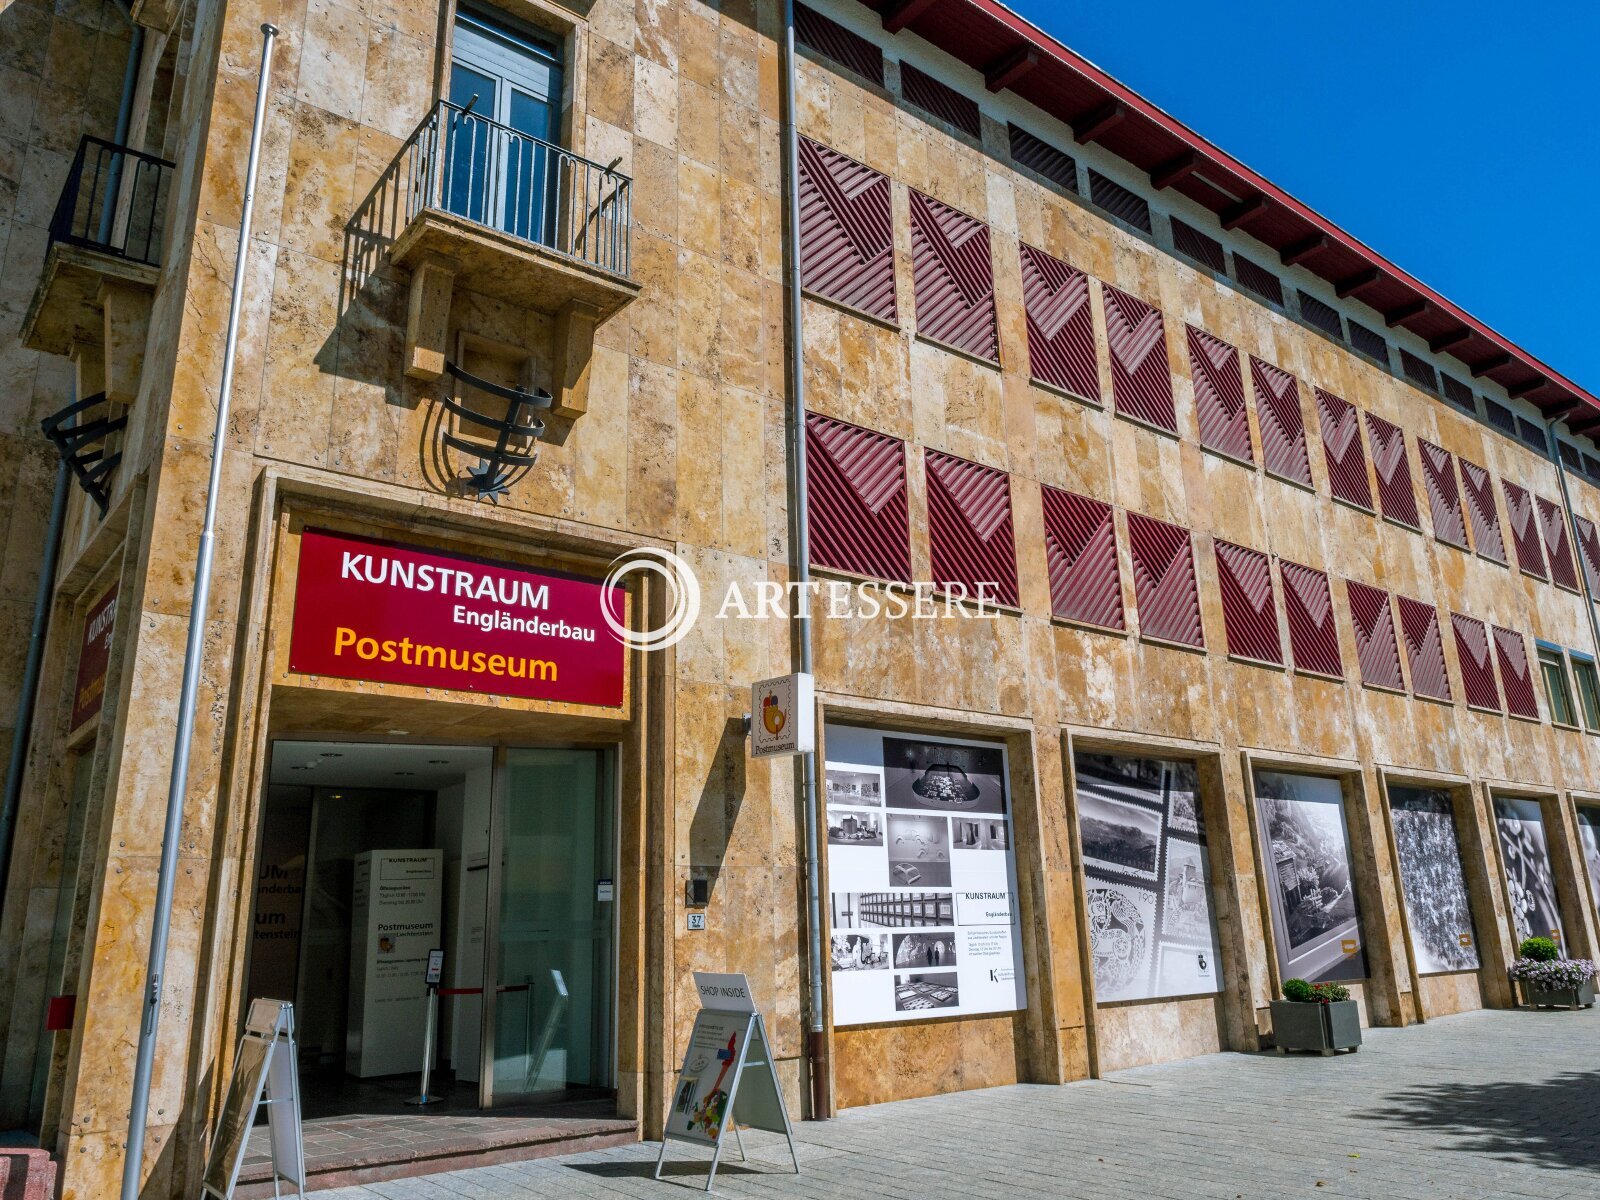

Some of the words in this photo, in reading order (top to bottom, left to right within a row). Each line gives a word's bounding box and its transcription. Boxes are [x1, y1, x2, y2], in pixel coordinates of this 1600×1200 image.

[340, 550, 550, 611] KUNSTRAUM
[452, 604, 596, 643] Engländerbau
[334, 626, 558, 682] Postmuseum
[755, 742, 795, 755] Postmuseum
[965, 892, 1006, 900] KUNSTRAUM
[691, 915, 702, 924] 37
[377, 922, 434, 931] Postmuseum
[700, 985, 720, 997] SHOP
[721, 987, 746, 998] INSIDE
